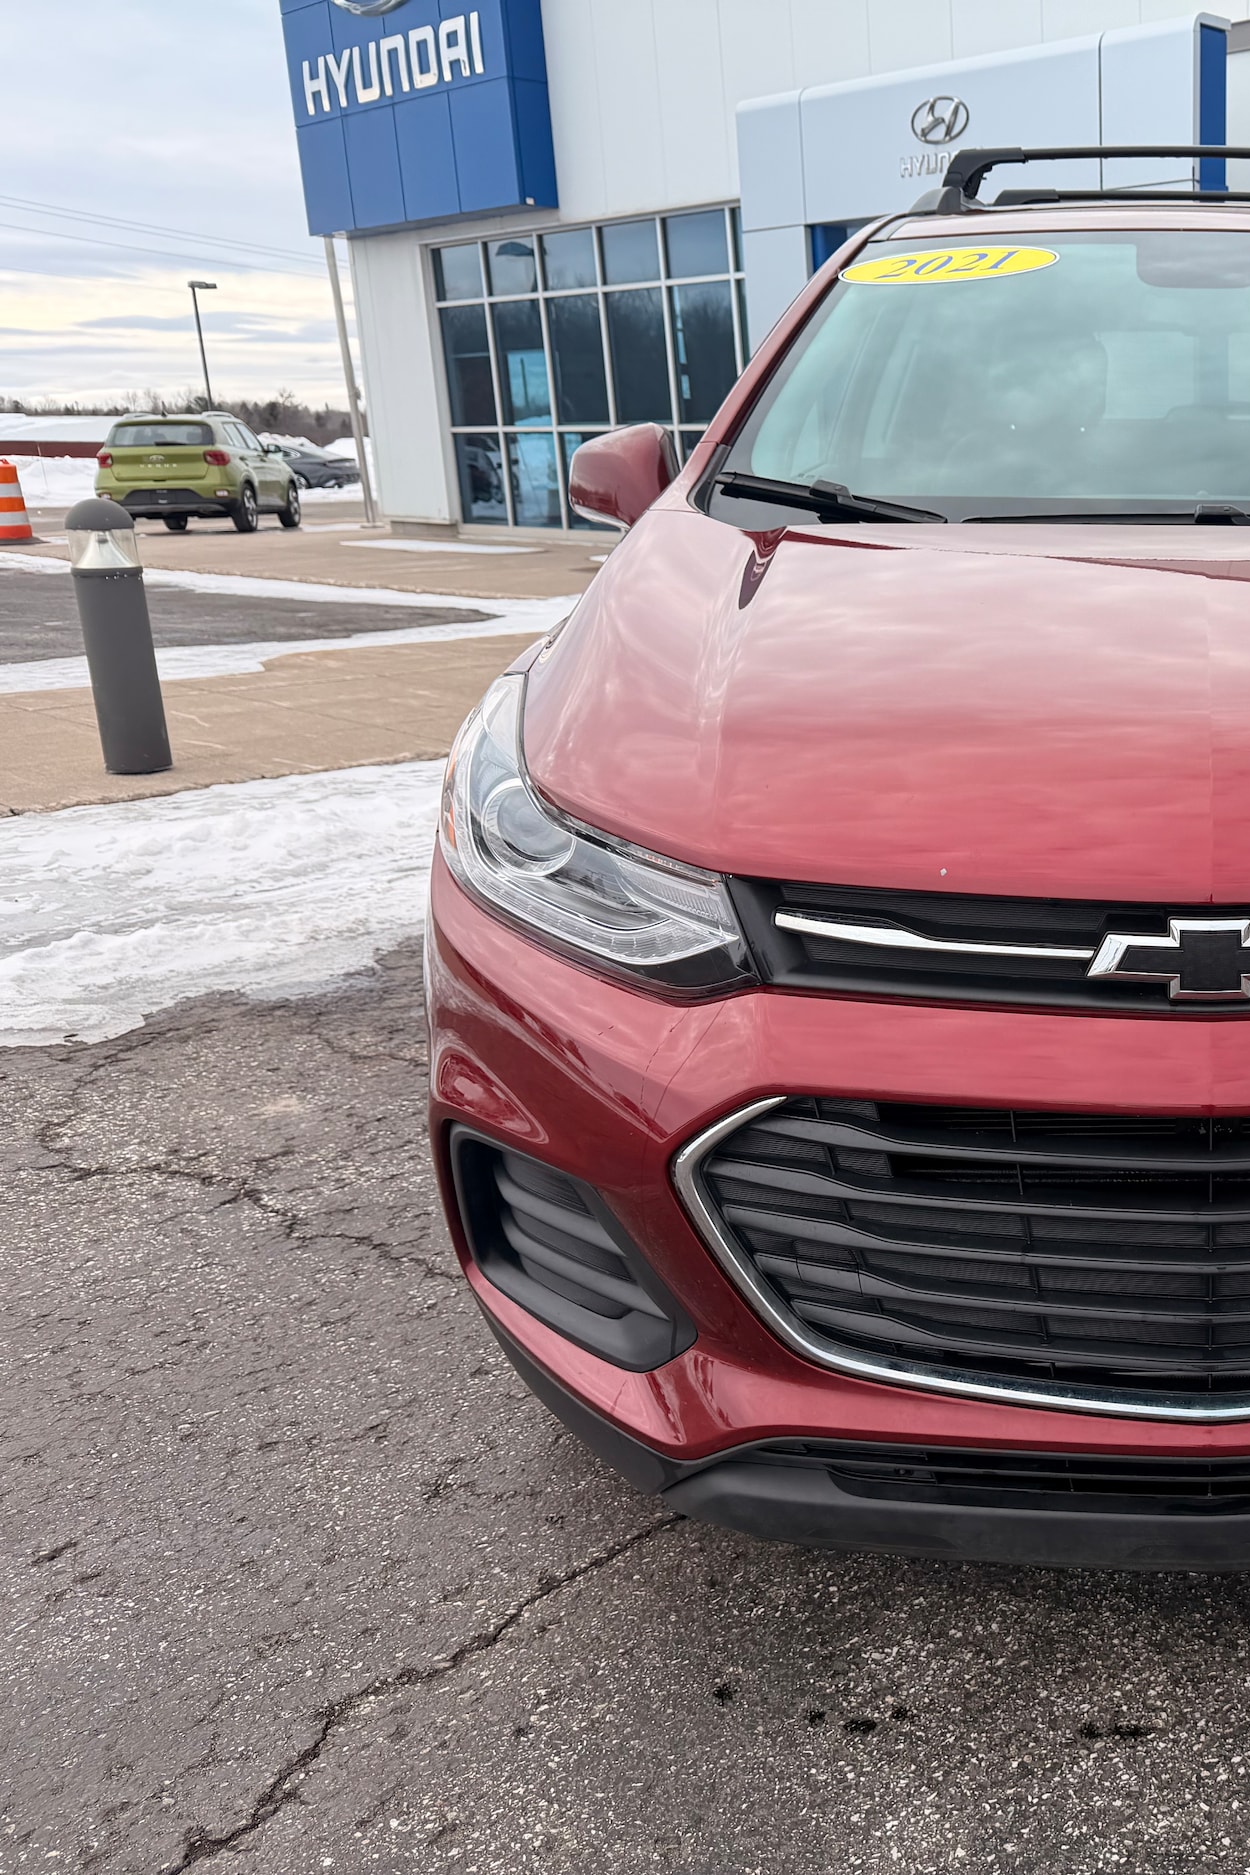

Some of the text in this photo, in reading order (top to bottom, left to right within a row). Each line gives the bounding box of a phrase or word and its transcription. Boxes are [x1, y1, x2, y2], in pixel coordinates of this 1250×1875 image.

[302, 11, 484, 115] HYUNDAI
[900, 151, 956, 178] HYUN
[874, 250, 1020, 279] 2021
